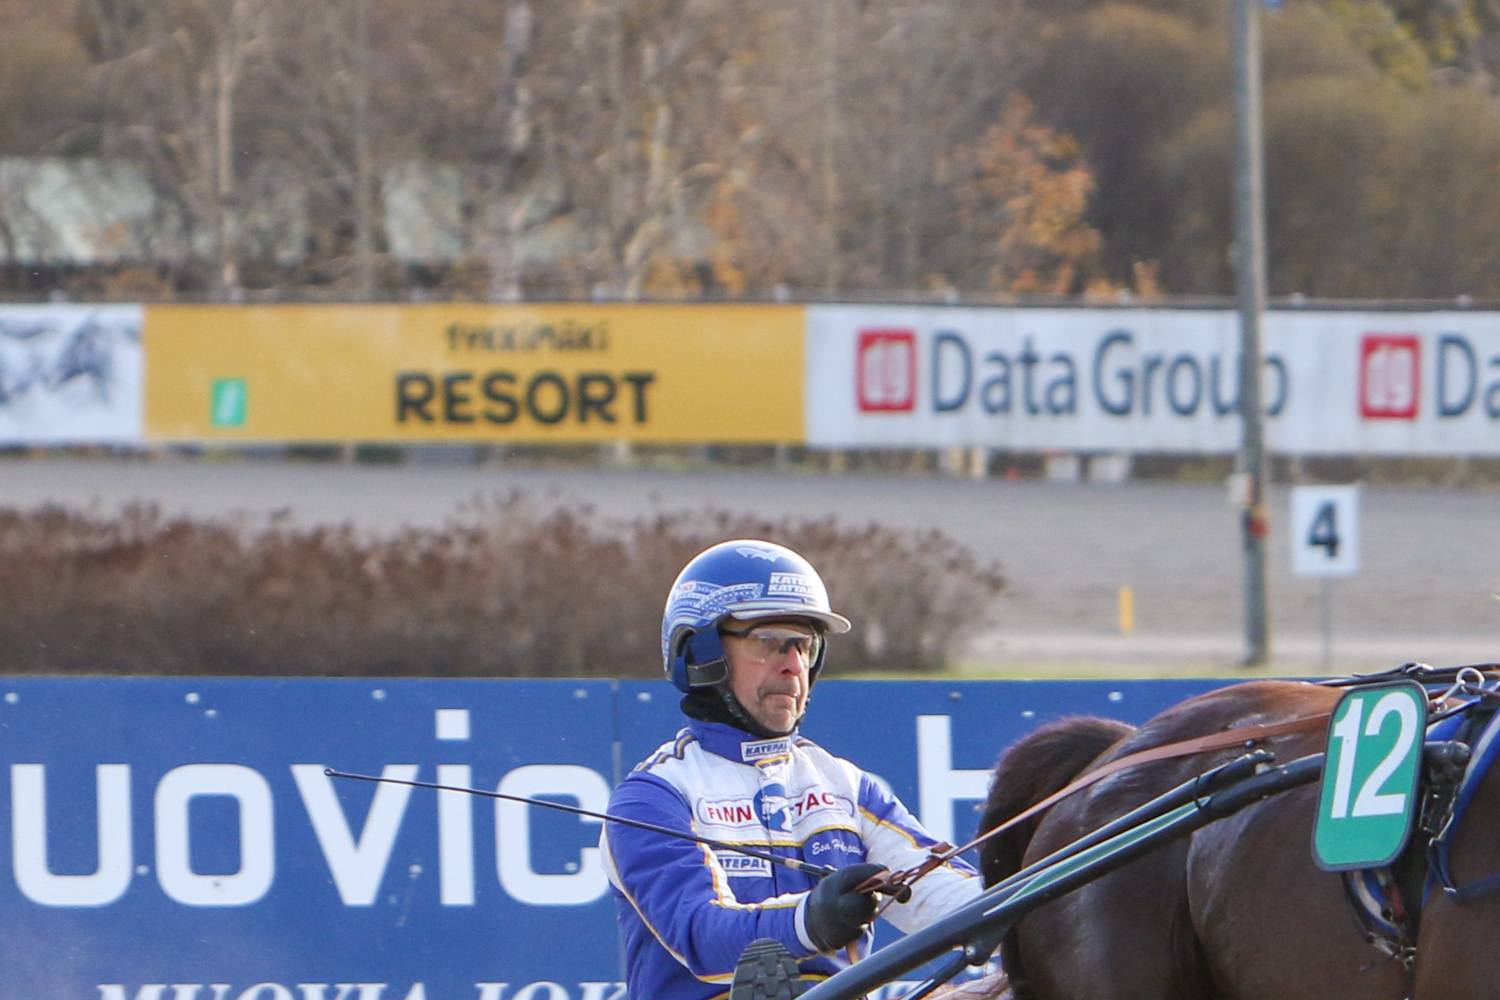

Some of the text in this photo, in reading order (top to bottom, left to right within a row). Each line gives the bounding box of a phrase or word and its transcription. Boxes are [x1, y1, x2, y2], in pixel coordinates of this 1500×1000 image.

[395, 371, 656, 425] RESORT
[1307, 499, 1340, 558] 4
[1331, 691, 1419, 819] 12
[707, 805, 753, 823] FINN
[718, 858, 767, 868] TEPAL
